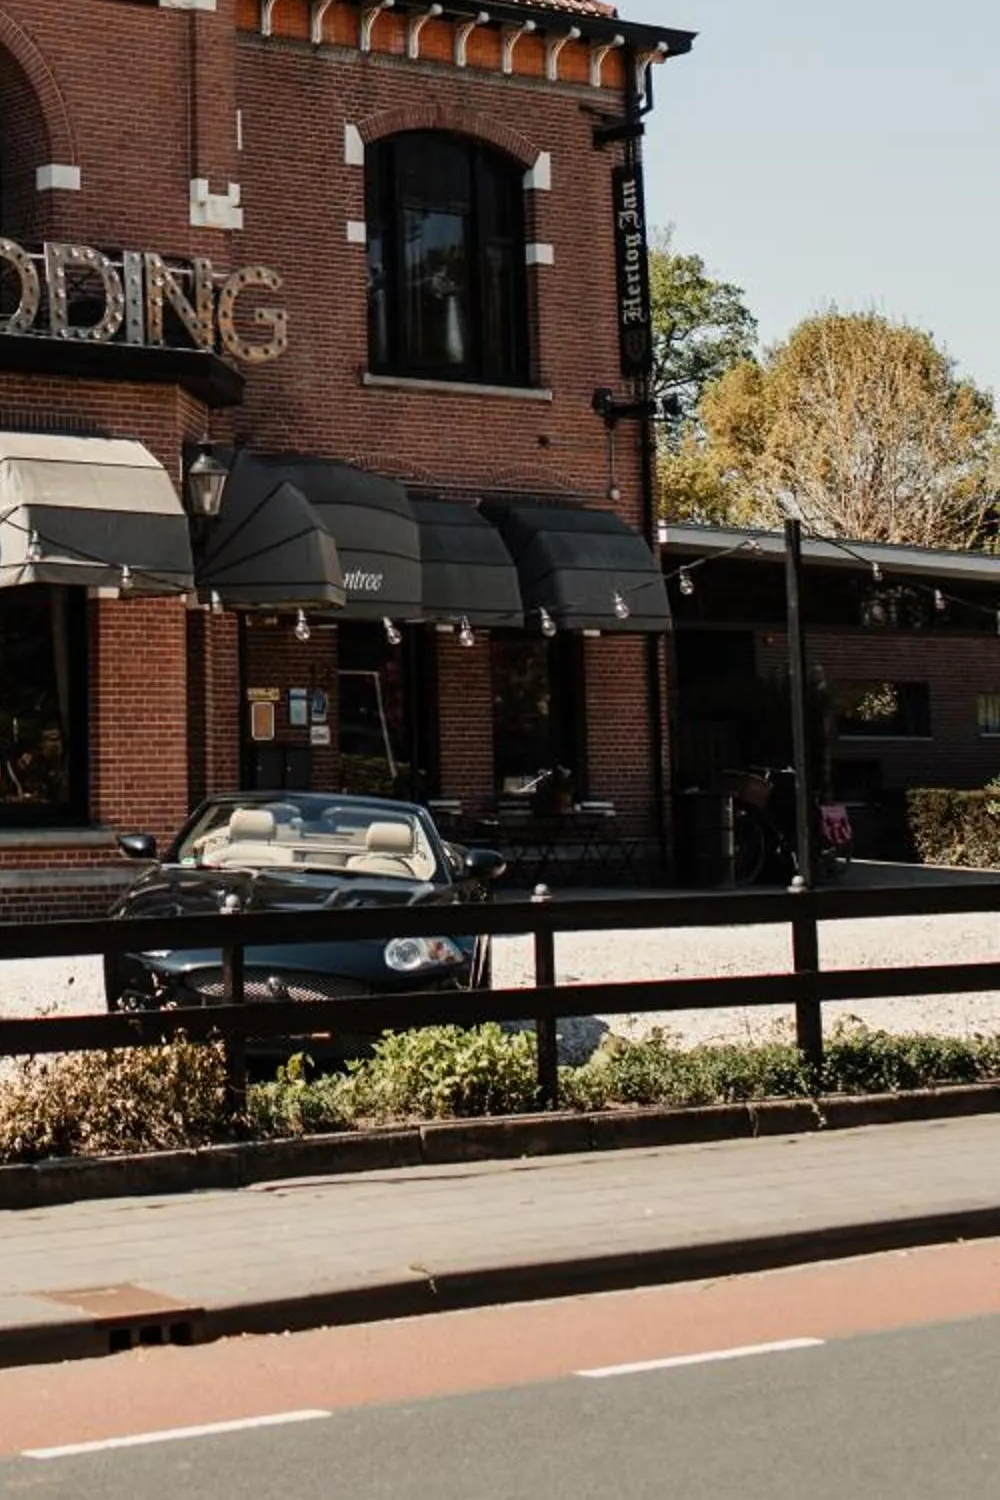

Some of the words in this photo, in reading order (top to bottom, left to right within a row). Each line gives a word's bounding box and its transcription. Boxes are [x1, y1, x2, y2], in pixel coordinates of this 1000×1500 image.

[617, 178, 642, 230] Jan
[621, 232, 648, 325] Hertog
[343, 569, 384, 592] ntree
